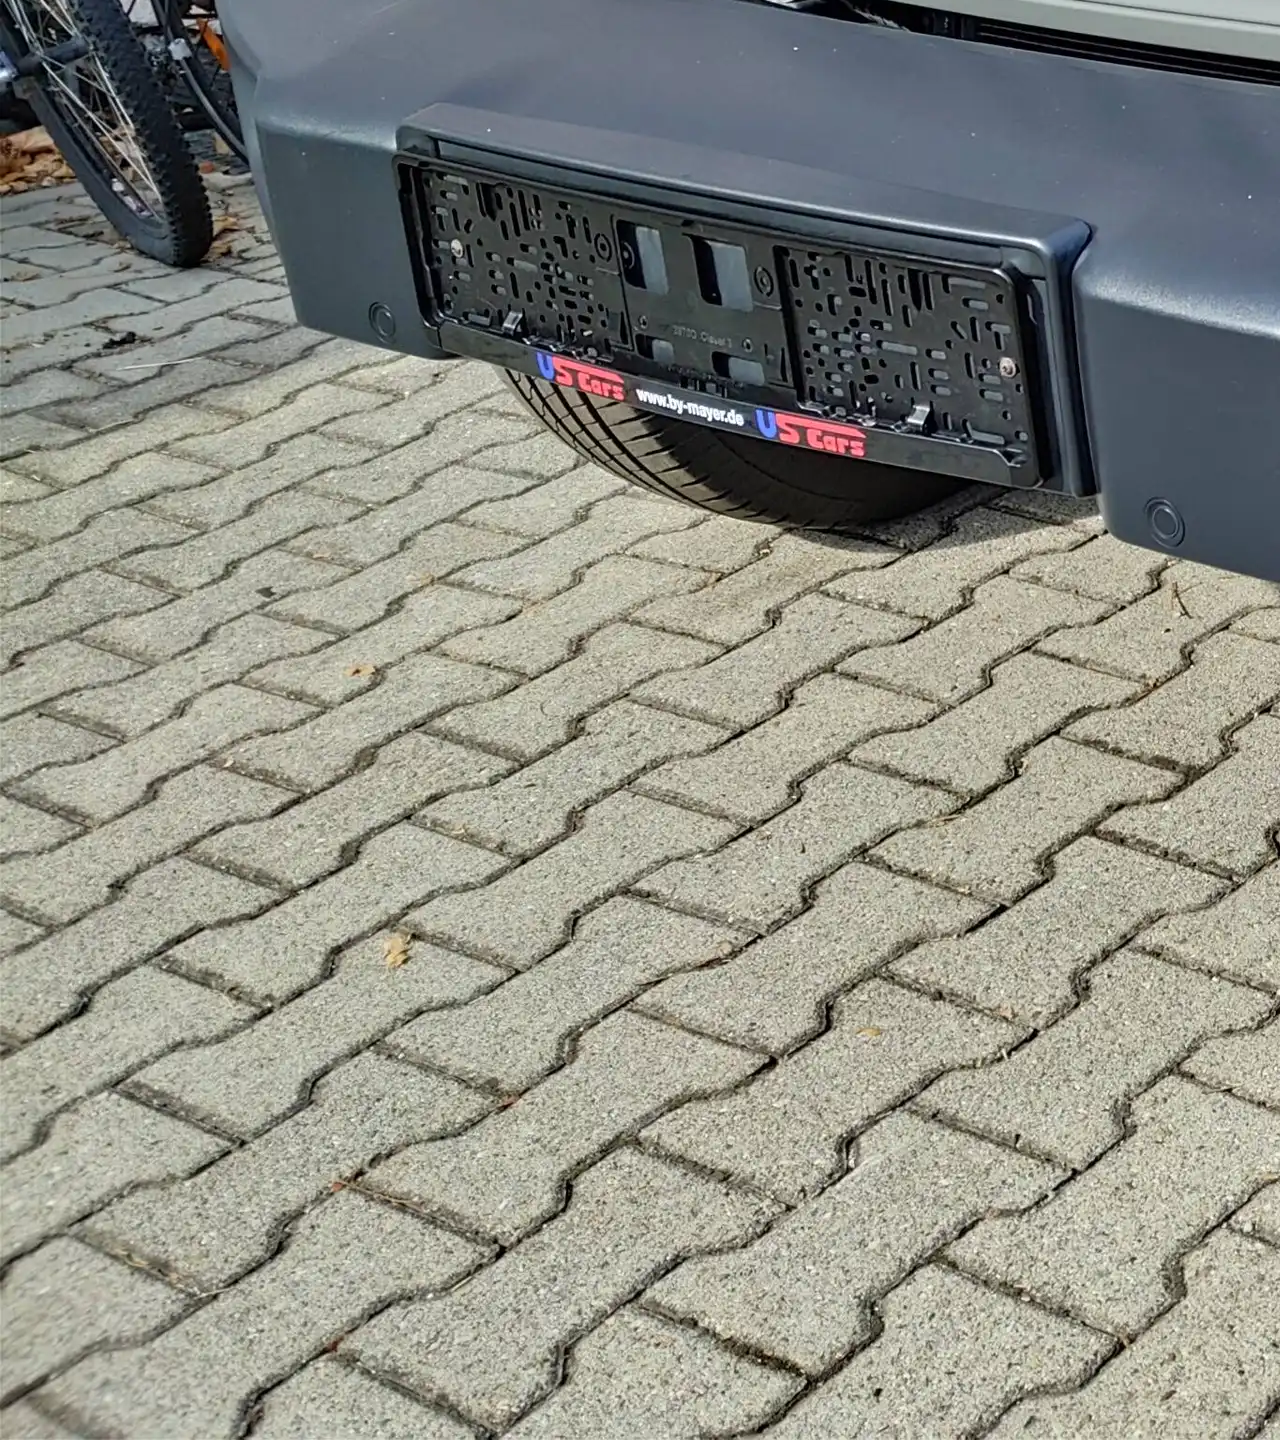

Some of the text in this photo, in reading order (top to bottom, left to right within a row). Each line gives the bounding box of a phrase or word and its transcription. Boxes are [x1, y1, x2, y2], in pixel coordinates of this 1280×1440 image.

[536, 351, 573, 387] US
[577, 371, 625, 401] Cars
[635, 387, 745, 427] www.by-mayer.de
[755, 408, 800, 444] US
[806, 428, 866, 458] Cars
